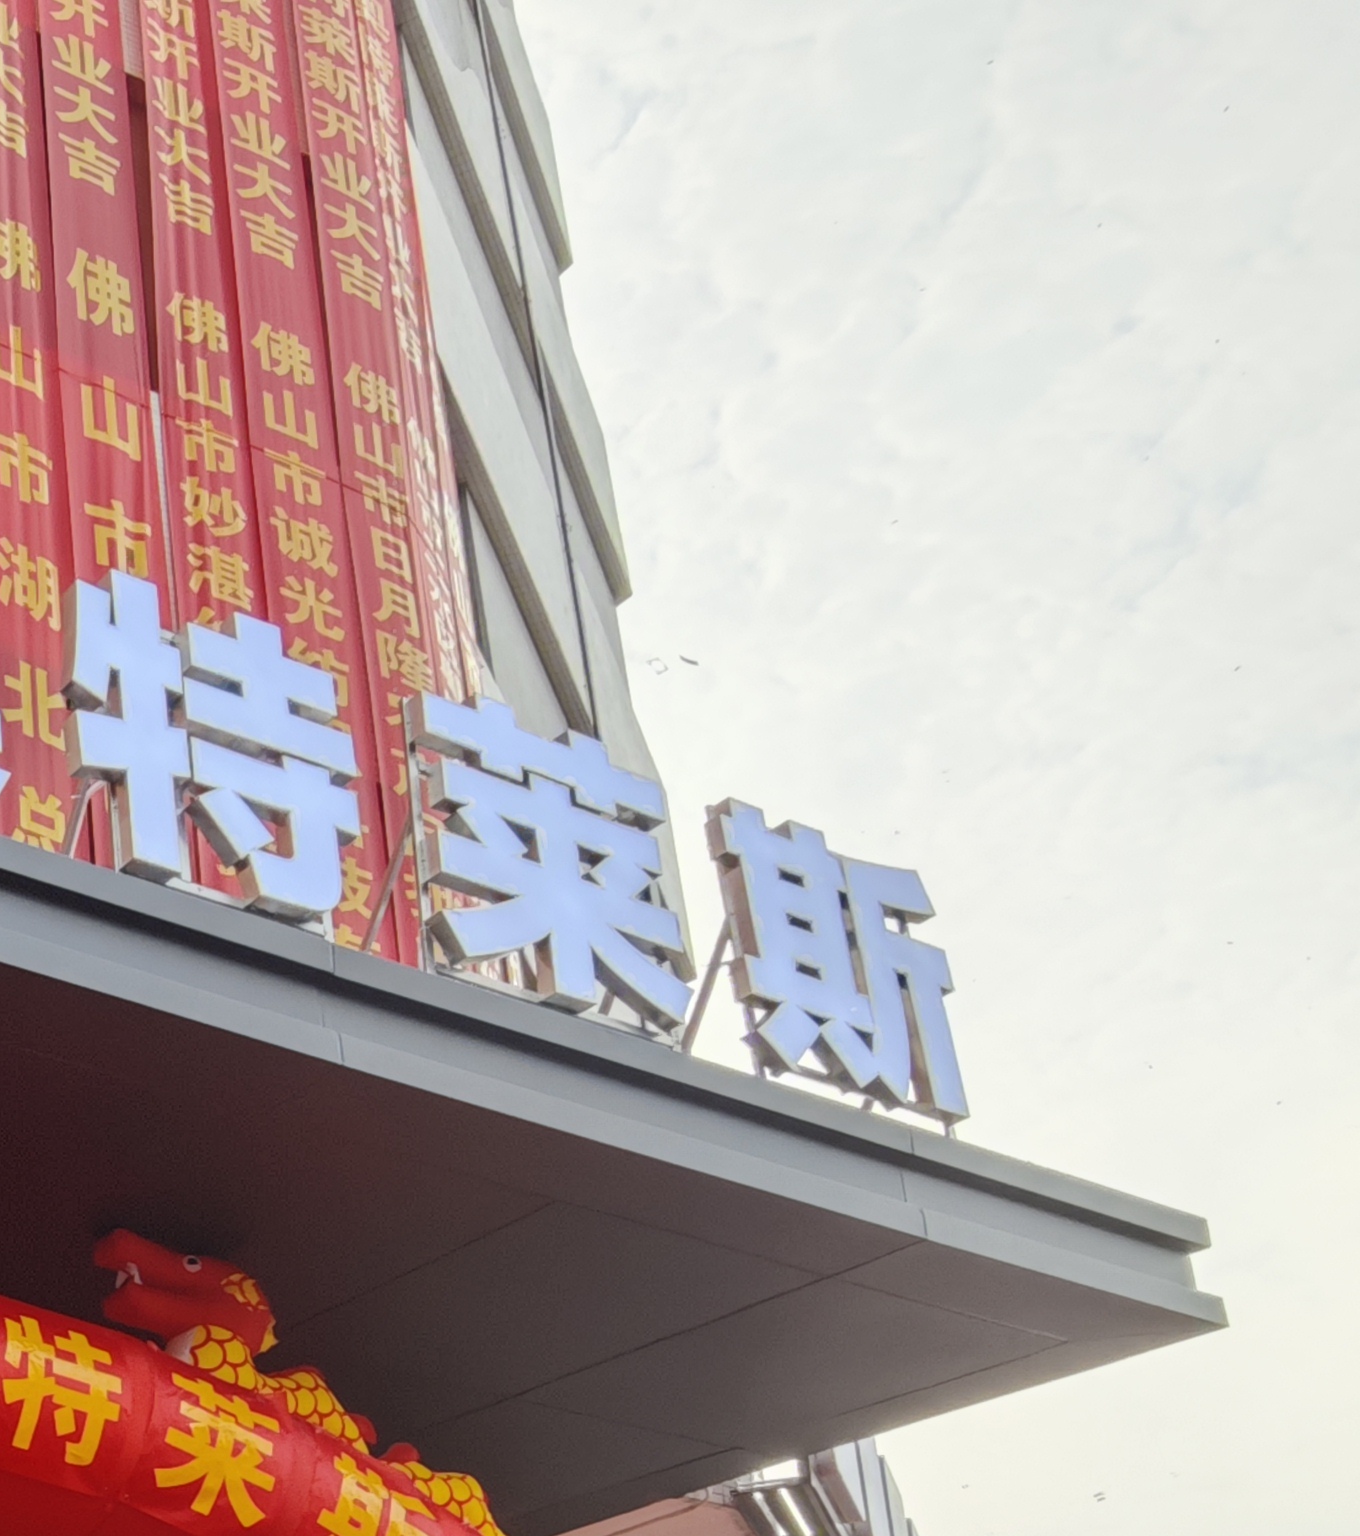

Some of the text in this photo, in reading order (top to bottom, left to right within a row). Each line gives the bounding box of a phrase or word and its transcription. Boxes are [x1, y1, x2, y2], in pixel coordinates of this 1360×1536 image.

[165, 292, 254, 632] 佛山市妙湛
